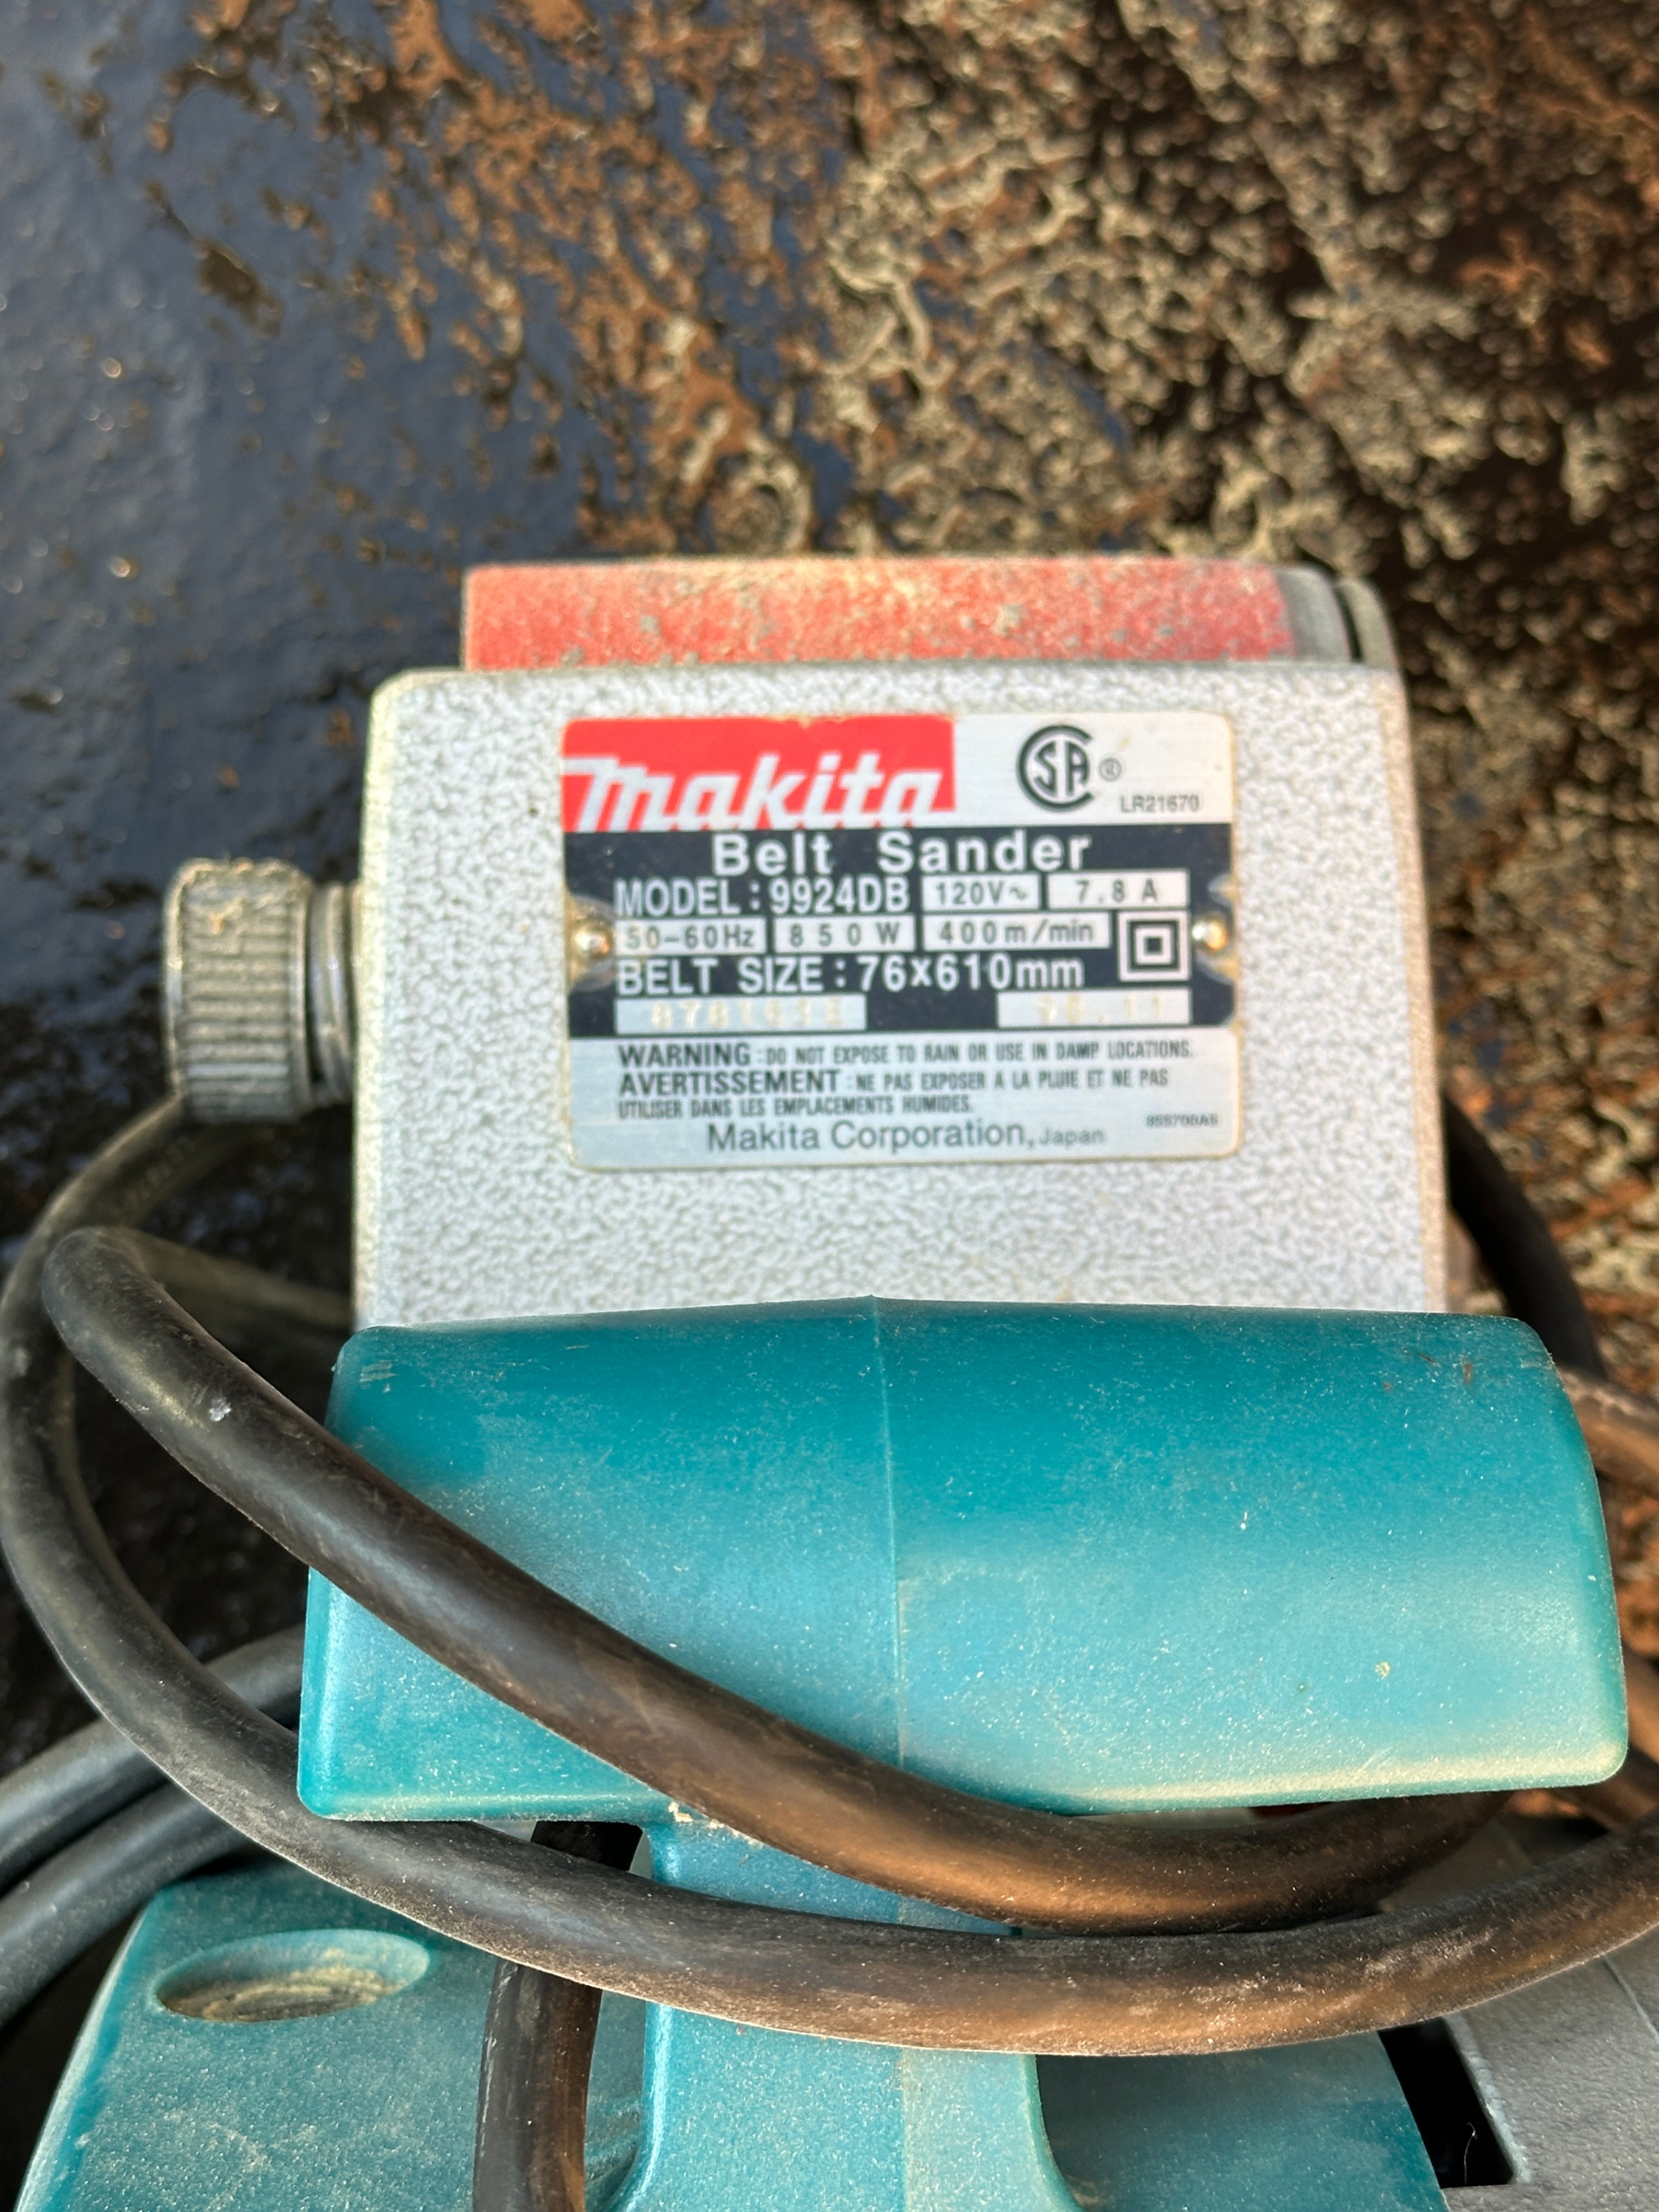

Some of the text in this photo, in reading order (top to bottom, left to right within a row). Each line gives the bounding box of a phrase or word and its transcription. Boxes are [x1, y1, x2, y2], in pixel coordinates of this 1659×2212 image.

[561, 752, 956, 832] makita
[1120, 794, 1200, 815] LR21670
[713, 828, 1093, 876] Belt Sander
[769, 874, 910, 913] 9924DB
[626, 921, 755, 950] 50-60Hz
[617, 956, 718, 995] BELT
[765, 1047, 787, 1065] DO
[795, 1046, 824, 1065] NOT
[833, 1044, 888, 1064] EXPOSE
[897, 1044, 915, 1063] TO
[924, 1043, 960, 1062] RAIN
[968, 1043, 988, 1062] OR
[996, 1042, 1023, 1062] USE
[1033, 1042, 1048, 1060] IN
[1056, 1041, 1100, 1060] DAMP
[855, 1074, 875, 1093] NE
[884, 1073, 913, 1091] PAS
[921, 1070, 986, 1090] EXPOSER
[1013, 1070, 1030, 1088] LA
[1038, 1070, 1079, 1088] PLUIE
[1087, 1070, 1104, 1087] ET
[1112, 1069, 1132, 1087] NE
[1139, 1068, 1168, 1086] PAS
[618, 1099, 683, 1120] UTILISER
[691, 1098, 731, 1118] DANS
[739, 1097, 766, 1116] LES
[774, 1096, 894, 1116] EMPLACEMENTS
[707, 1122, 820, 1152] Makita
[1038, 1126, 1107, 1147] Japan
